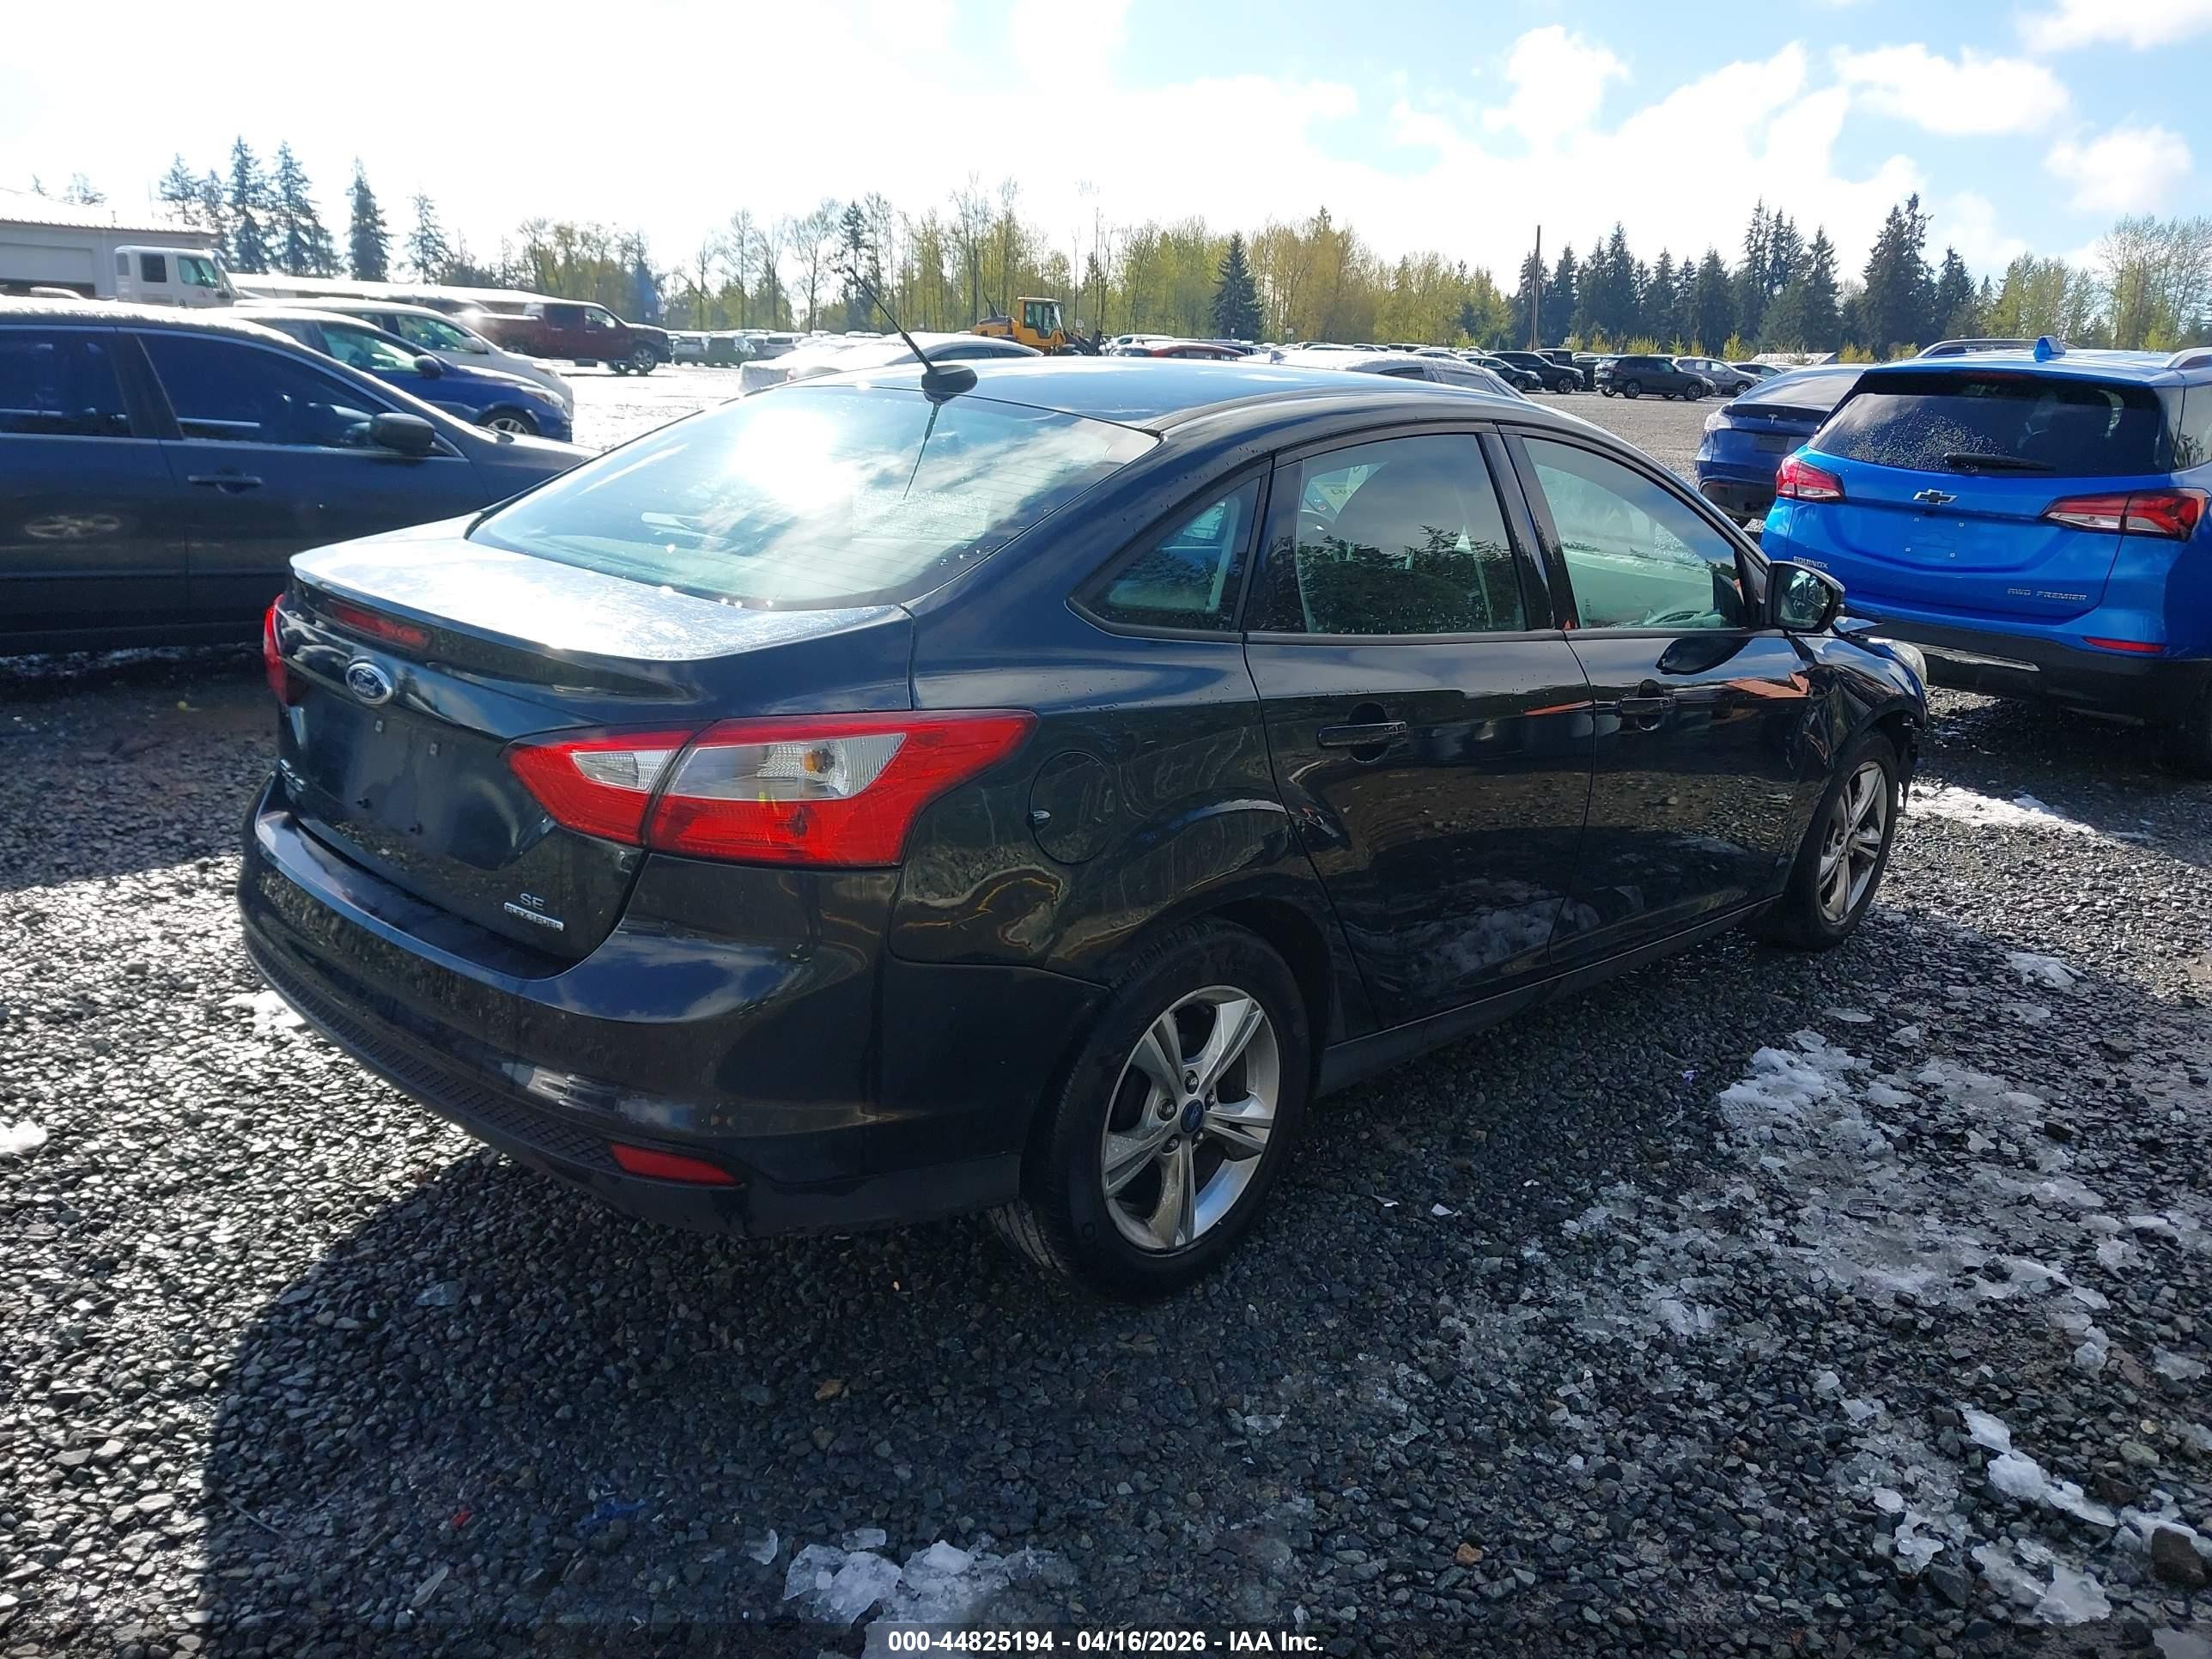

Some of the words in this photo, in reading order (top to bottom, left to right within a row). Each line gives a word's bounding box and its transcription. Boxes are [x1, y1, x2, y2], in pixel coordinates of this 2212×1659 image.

[1793, 556, 1828, 569] EQUINOX
[2036, 591, 2087, 601] PREMIER
[520, 893, 544, 911] SE
